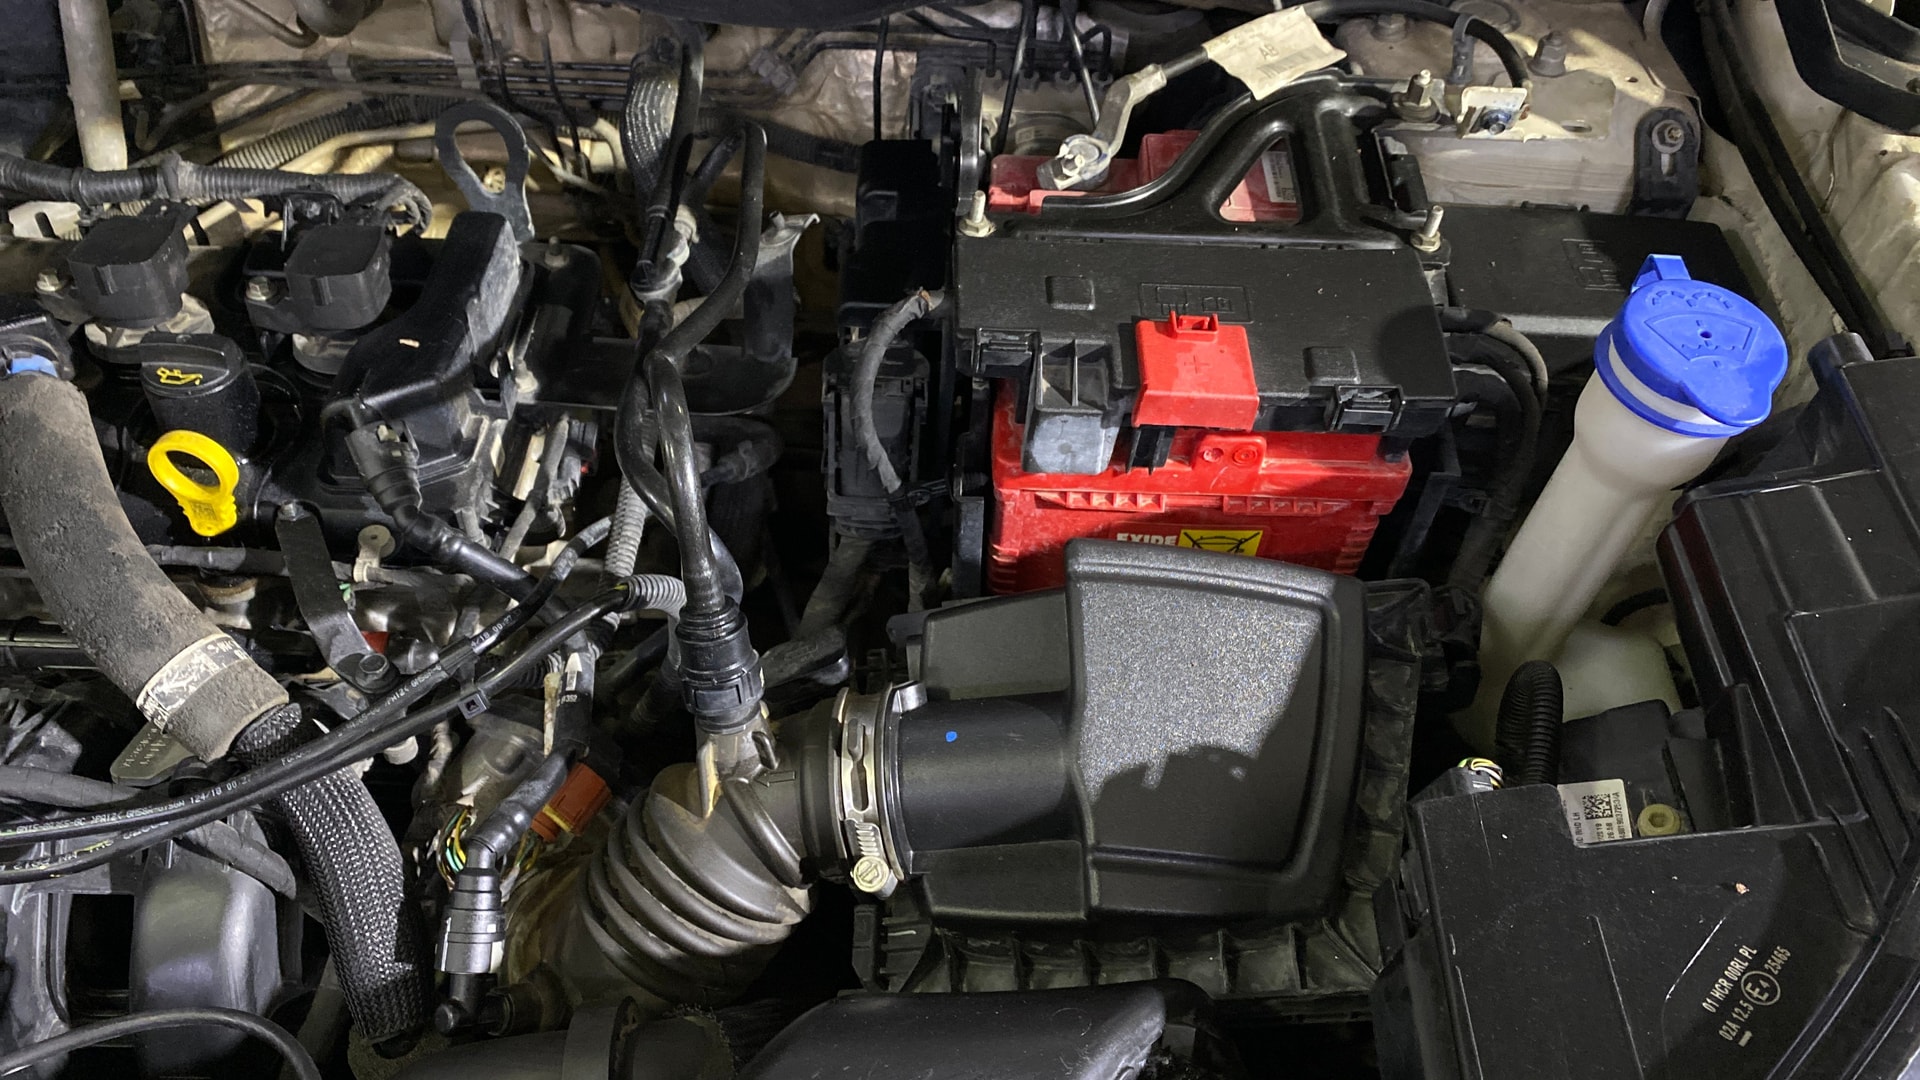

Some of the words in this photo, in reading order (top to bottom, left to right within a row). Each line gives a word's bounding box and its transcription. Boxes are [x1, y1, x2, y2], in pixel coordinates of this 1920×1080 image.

[1739, 945, 1758, 960] PL
[1710, 978, 1734, 1001] HCR
[1719, 1020, 1741, 1041] 02A
[1731, 1000, 1754, 1022] 12.5
[1764, 946, 1791, 975] 25465
[1702, 997, 1720, 1013] 01
